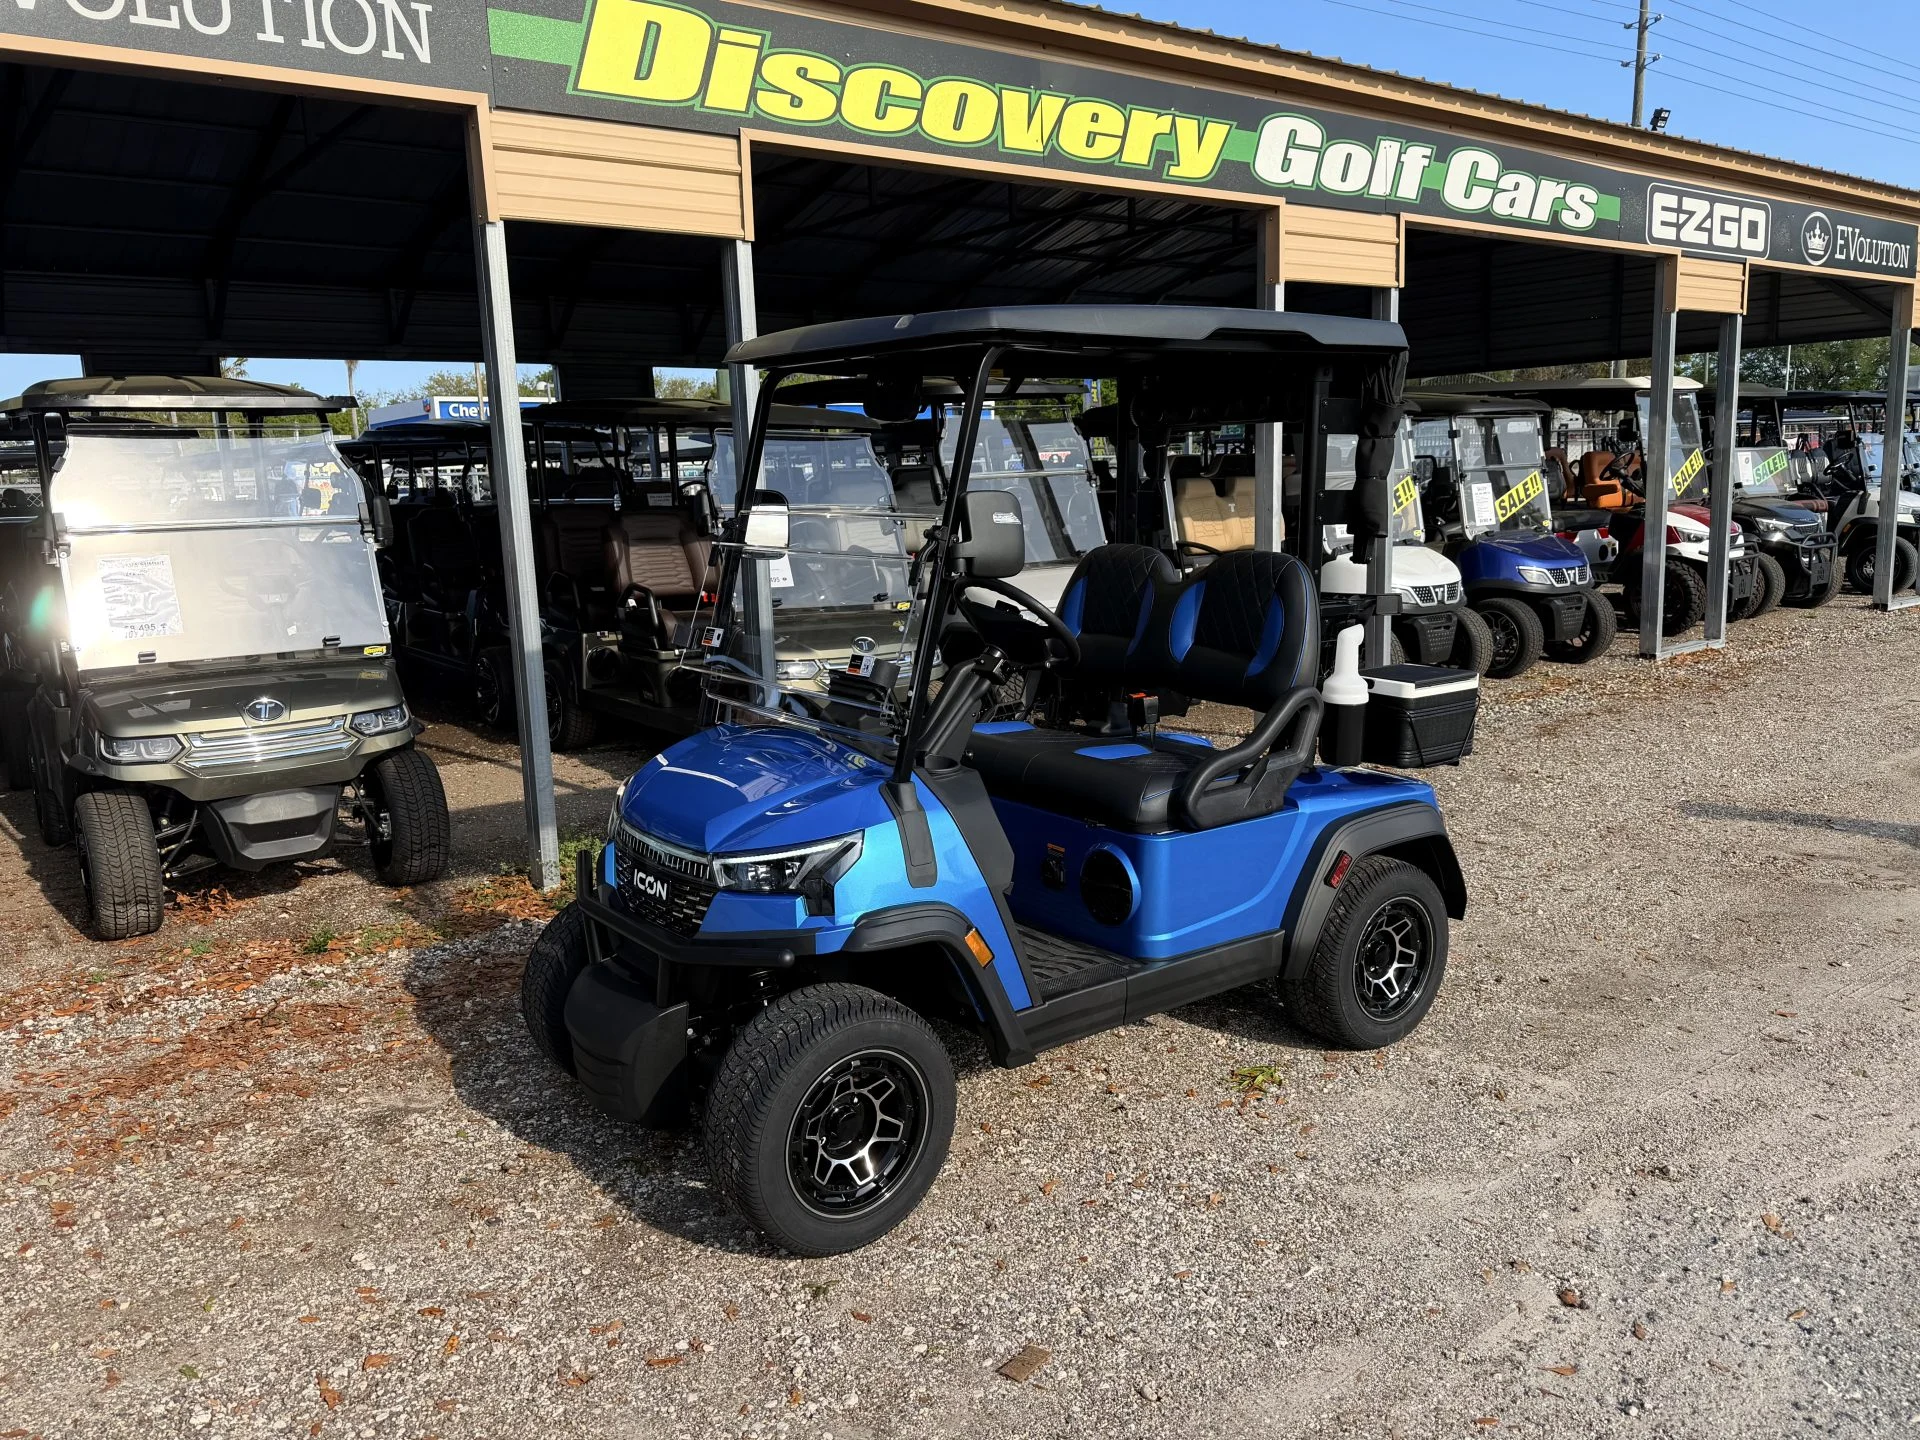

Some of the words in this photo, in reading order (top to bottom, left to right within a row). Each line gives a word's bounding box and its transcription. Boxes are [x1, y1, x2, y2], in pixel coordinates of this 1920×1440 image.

[18, 0, 433, 63] UTION
[577, 0, 1231, 179] Discovery
[1254, 116, 1433, 200] Golf
[1443, 150, 1599, 228] Cars
[1674, 451, 1702, 492] SALE!!
[1754, 454, 1785, 482] SALE!!
[1498, 474, 1540, 518] SALE!!
[633, 868, 668, 901] ICON
